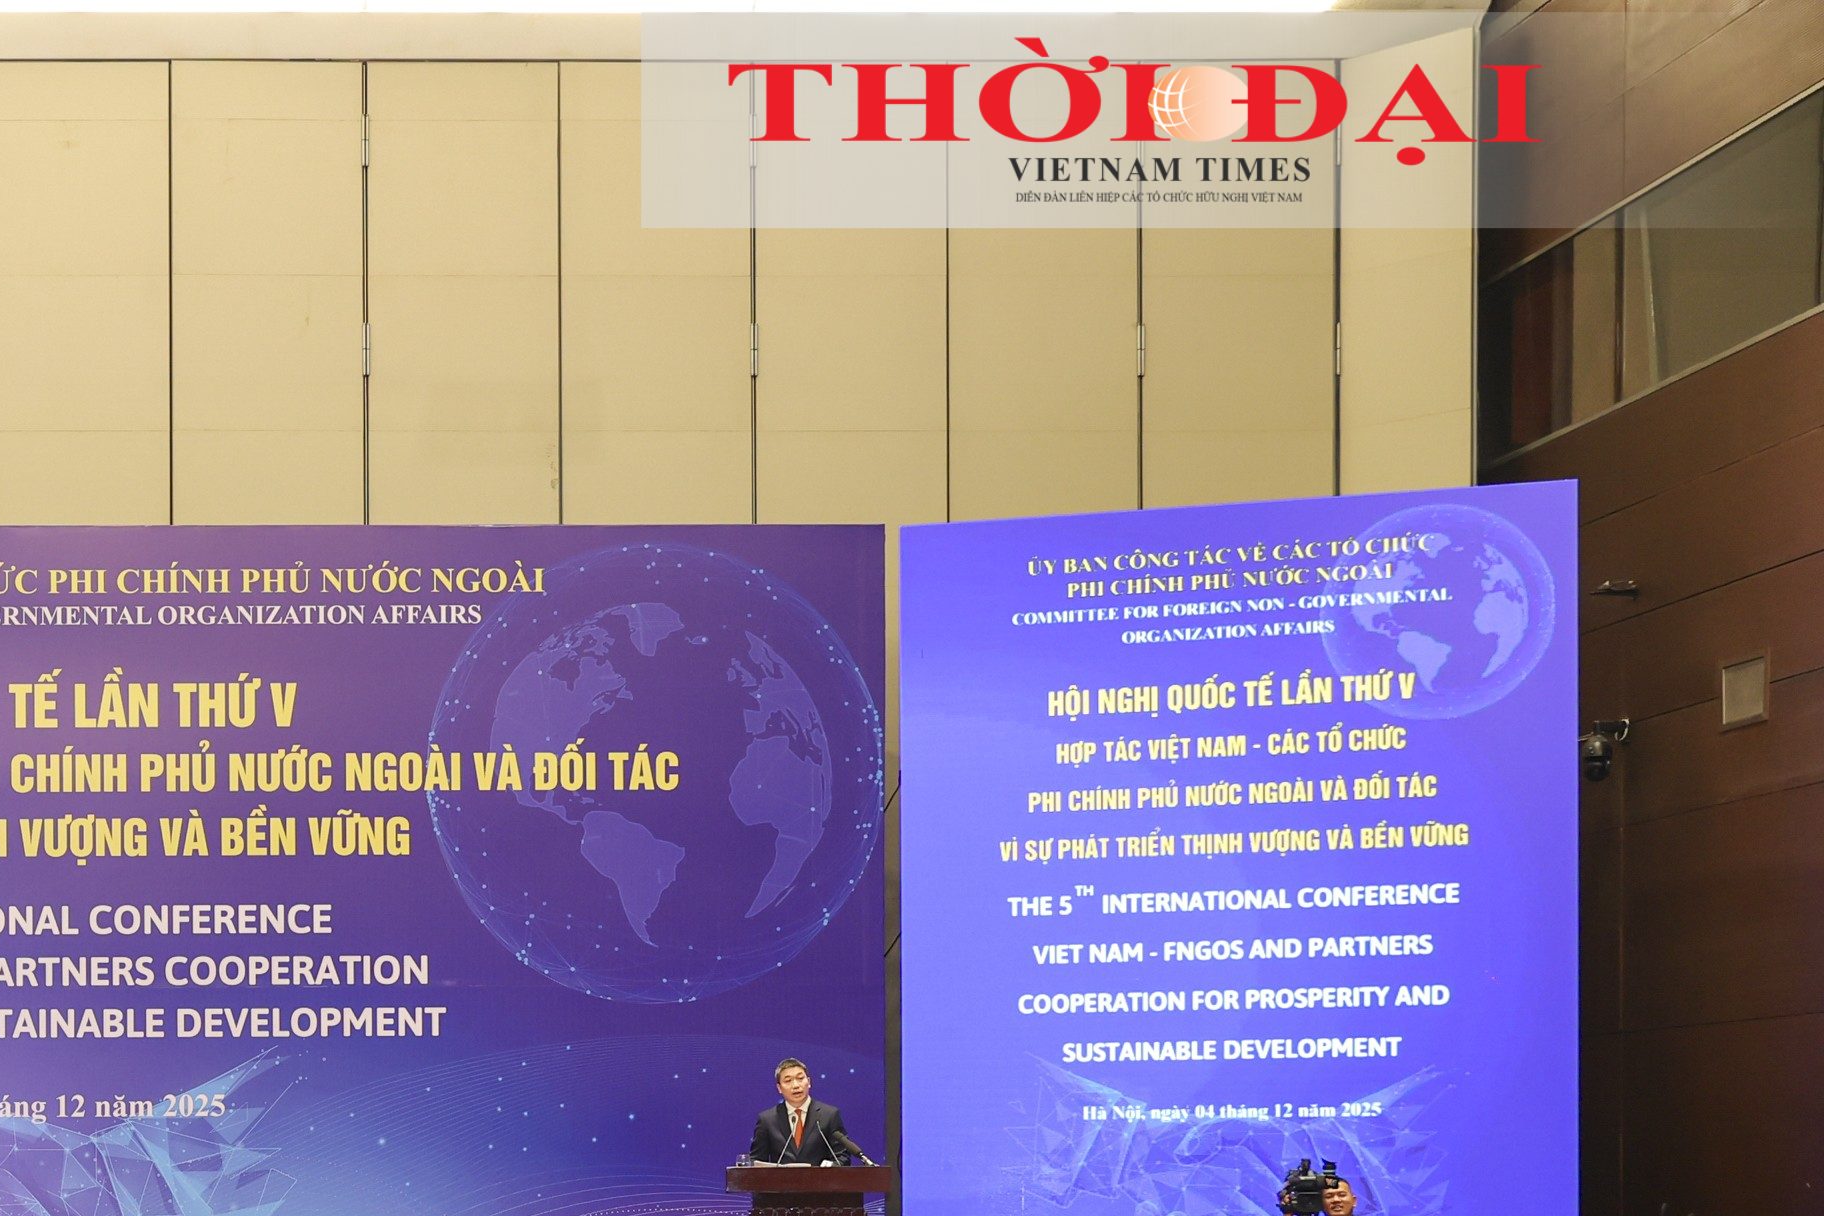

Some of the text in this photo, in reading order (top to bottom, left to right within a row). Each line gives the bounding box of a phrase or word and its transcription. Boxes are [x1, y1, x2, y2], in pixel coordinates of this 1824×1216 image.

[48, 570, 107, 593] PHI
[117, 562, 230, 593] CHÍNH
[241, 561, 310, 593] PHỦ
[320, 561, 421, 593] NƯỚC
[431, 561, 546, 595] NGOÀI
[158, 605, 364, 625] ORGANIZATION
[372, 605, 481, 624] AFFAIRS
[1012, 587, 1453, 625] COMMITTEE FOR FOREIGN NON GOVERNMENTAL
[1122, 620, 1335, 643] ORGANIZATION AFFAIRS
[9, 669, 62, 728] TẾ
[75, 665, 158, 727] LẦN
[173, 673, 261, 727] THỨ
[270, 683, 297, 727] V
[11, 746, 126, 793] CHÍNH
[141, 740, 215, 792] PHỦ
[229, 745, 331, 791] NƯỚC
[346, 744, 460, 792] NGOÀI
[474, 744, 522, 790] VÀ
[533, 738, 596, 791] ĐỐI
[608, 744, 678, 790] TÁC
[20, 814, 147, 865] VƯỢNG
[160, 810, 208, 856] VÀ
[221, 805, 295, 855] BỀN
[308, 809, 409, 856] VỮNG
[1007, 896, 1052, 916] THE
[1103, 889, 1292, 913] INTERNATIONAL
[1298, 883, 1459, 907] CONFERENCE
[90, 904, 332, 934] CONFERENCE
[1033, 935, 1433, 964] VIET NAM FNGOS AND PARTNERS
[165, 955, 428, 985] COOPERATION
[1018, 985, 1449, 1014] COOPERATION FOR PROSPERITY AND
[177, 1007, 446, 1037] DEVELOPMENT
[56, 1094, 86, 1118] 12
[94, 1094, 154, 1118] năm
[162, 1094, 226, 1118] 2025
[1083, 1102, 1381, 1123] Hà Nội, ngày 04 tháng 12 năm 2025
